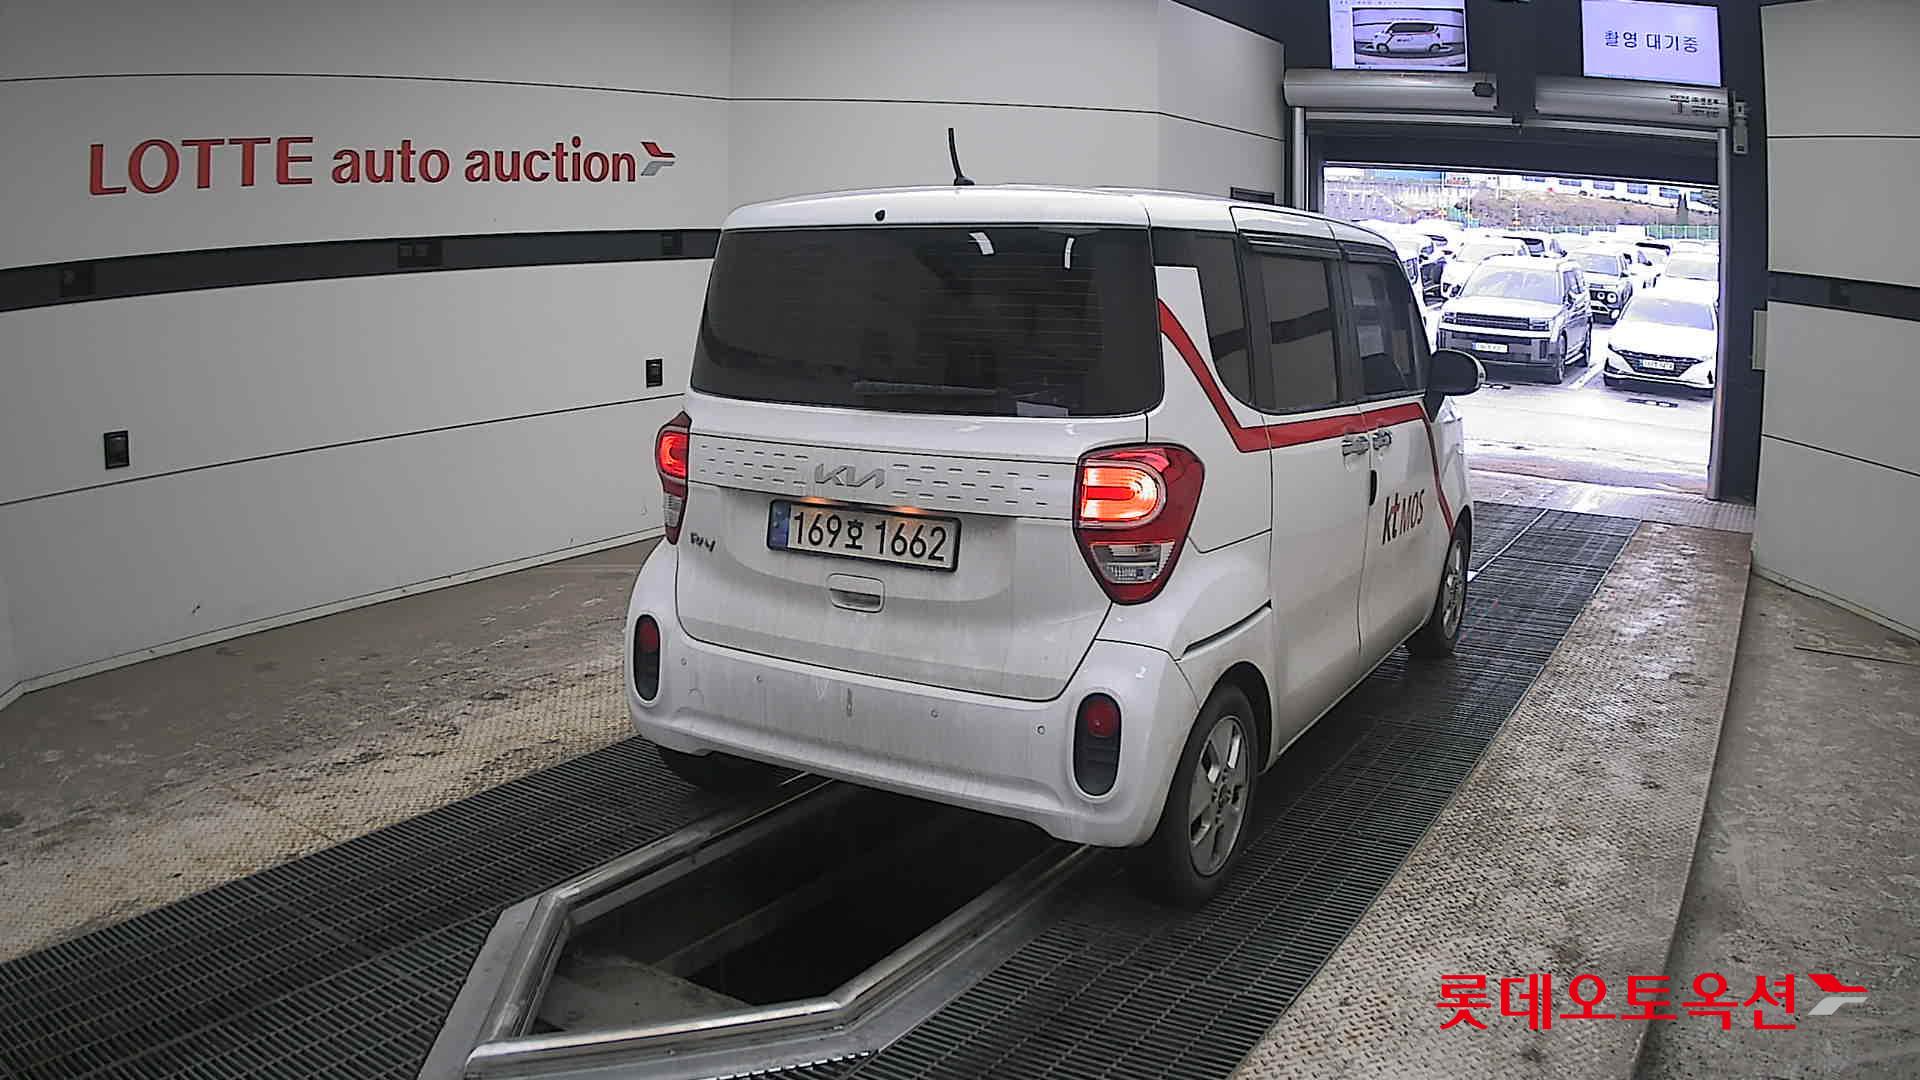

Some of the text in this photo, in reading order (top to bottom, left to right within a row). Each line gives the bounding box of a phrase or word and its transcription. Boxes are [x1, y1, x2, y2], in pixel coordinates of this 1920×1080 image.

[1604, 30, 1698, 53] 촬영 대기중
[89, 136, 638, 196] LOTTE auto auction
[794, 511, 947, 562] 169호 1662
